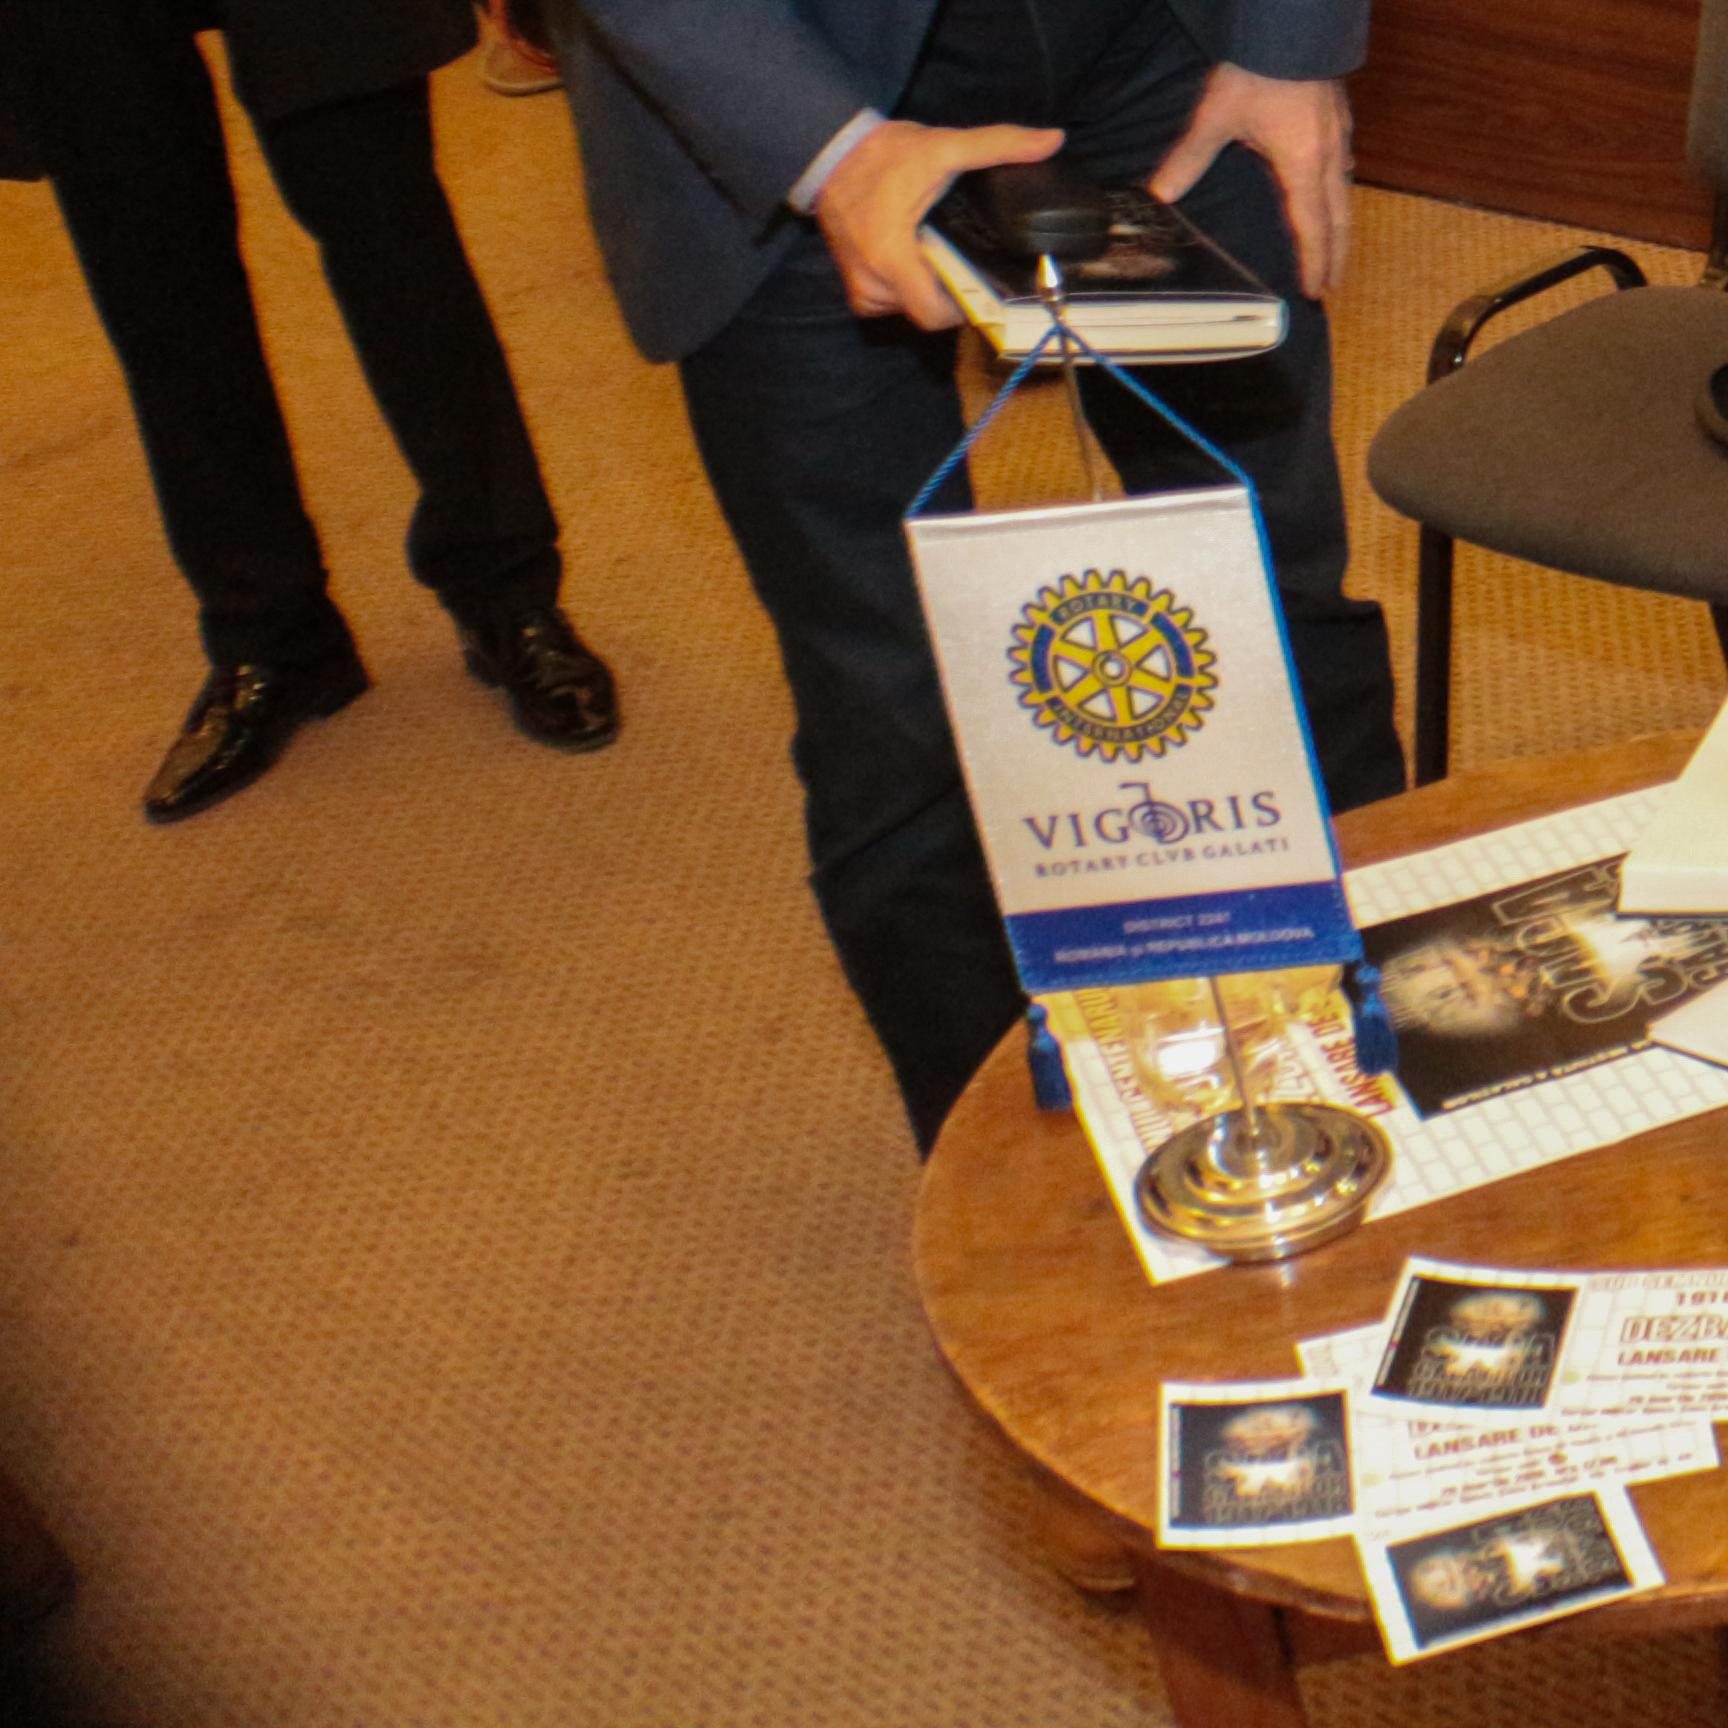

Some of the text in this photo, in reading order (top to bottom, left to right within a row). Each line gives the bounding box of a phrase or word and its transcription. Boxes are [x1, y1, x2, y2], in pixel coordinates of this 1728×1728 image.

[1059, 593, 1135, 619] ROTARY
[1034, 854, 1129, 878] ROTARY
[1617, 1347, 1719, 1367] LANSARE
[1414, 1427, 1521, 1461] LANSARE
